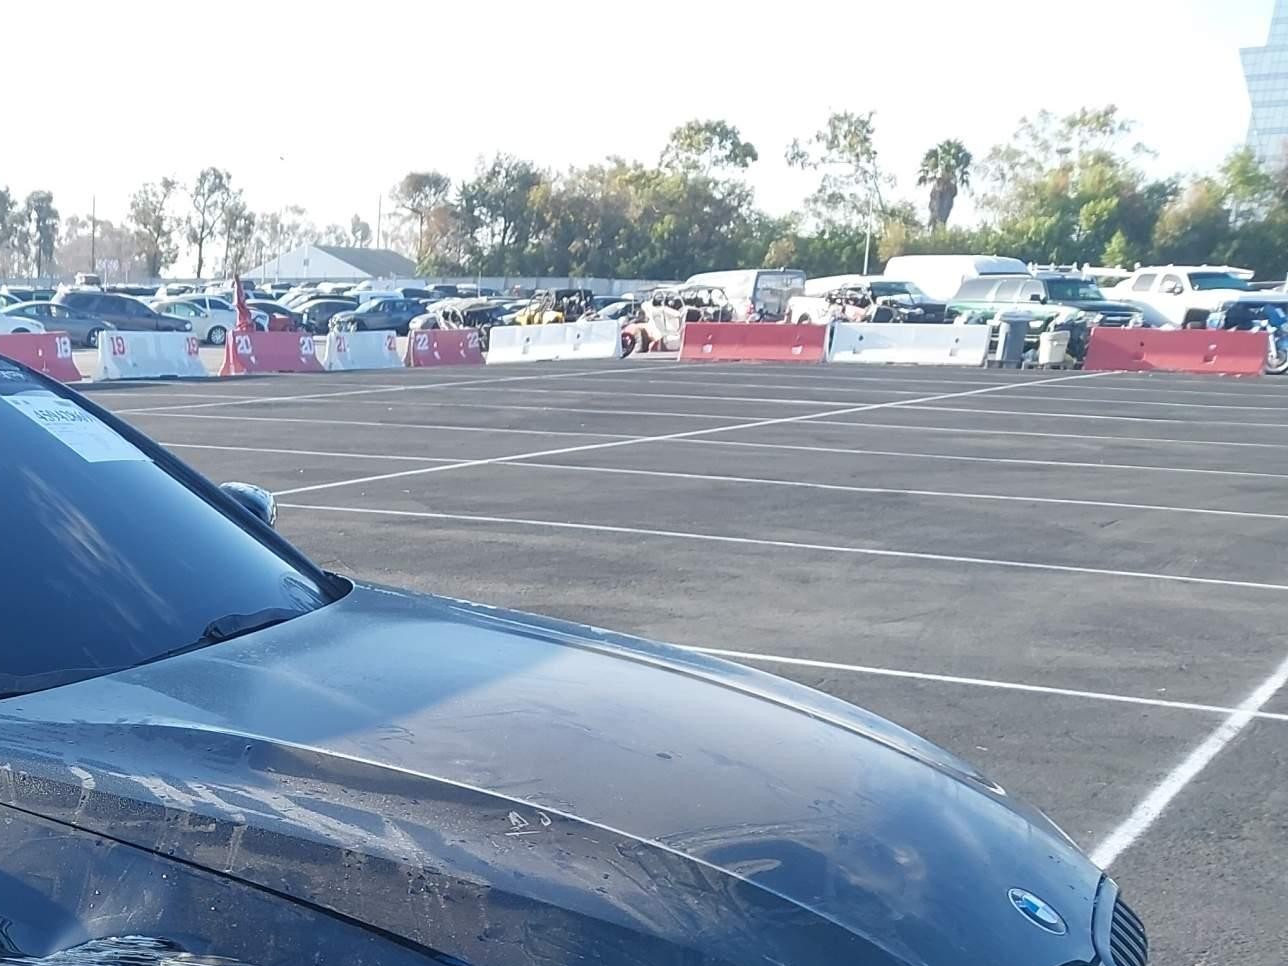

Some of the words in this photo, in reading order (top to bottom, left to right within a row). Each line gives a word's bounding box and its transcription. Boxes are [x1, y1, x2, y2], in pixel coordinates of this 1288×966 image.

[56, 336, 71, 359] 18
[110, 336, 125, 356] 19
[236, 335, 253, 354] 20
[300, 336, 313, 354] 20
[415, 334, 429, 350] 22
[466, 332, 479, 349] 22
